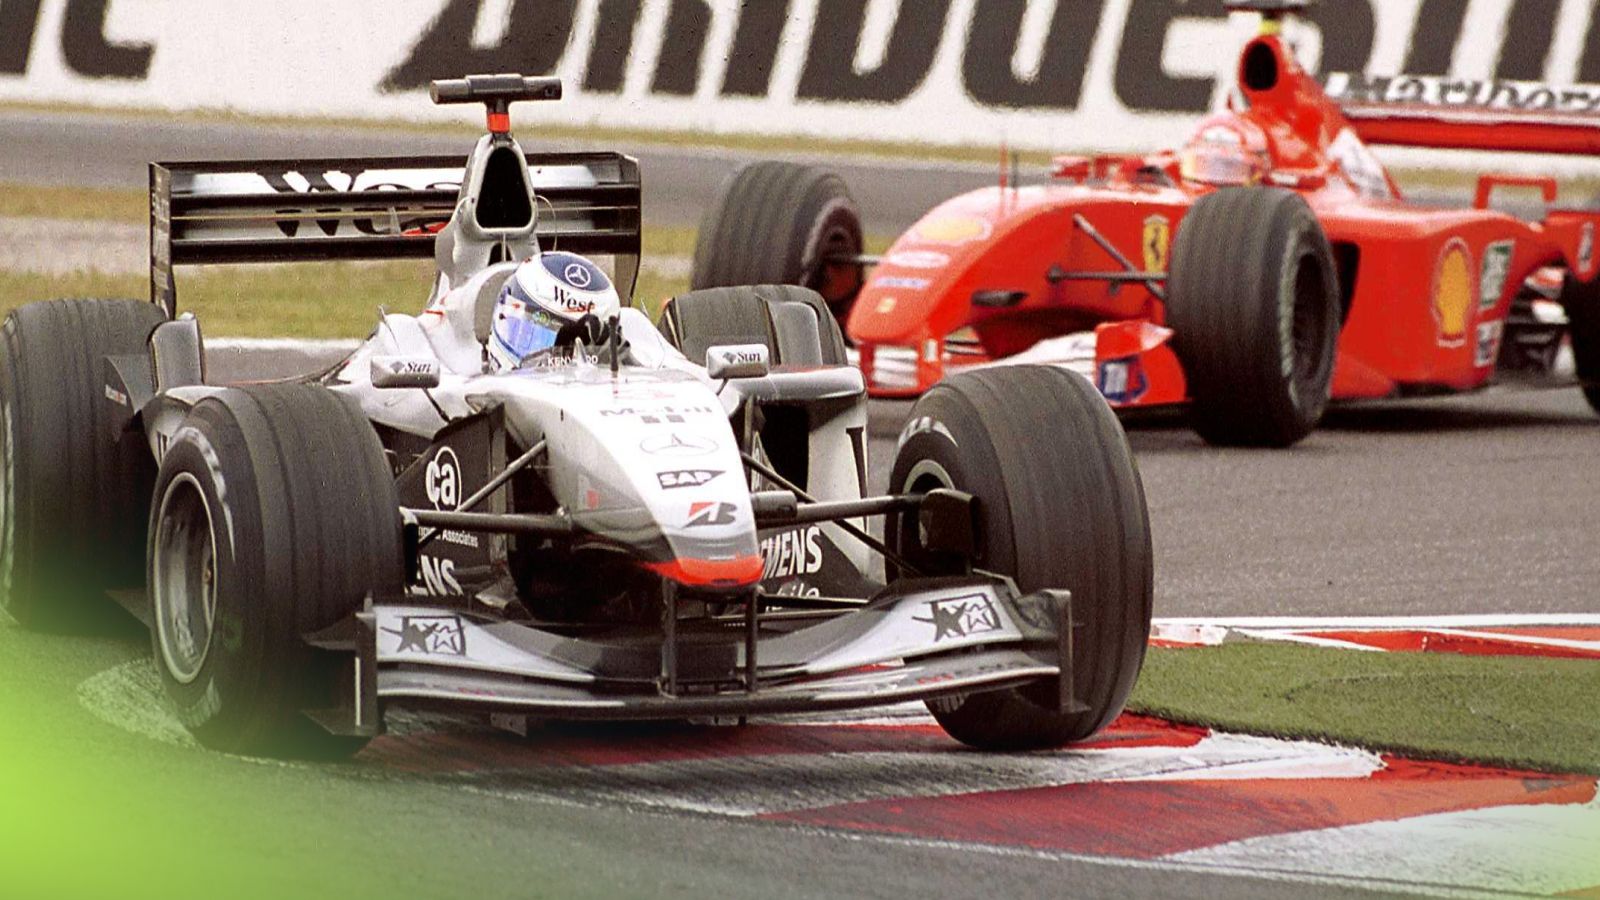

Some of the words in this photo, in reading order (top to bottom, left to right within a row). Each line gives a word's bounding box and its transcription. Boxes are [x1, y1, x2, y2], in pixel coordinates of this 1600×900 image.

[554, 285, 596, 314] West
[737, 351, 761, 362] Sun
[405, 361, 431, 373] Sun
[659, 470, 713, 486] SAP
[442, 529, 478, 547] Associates
